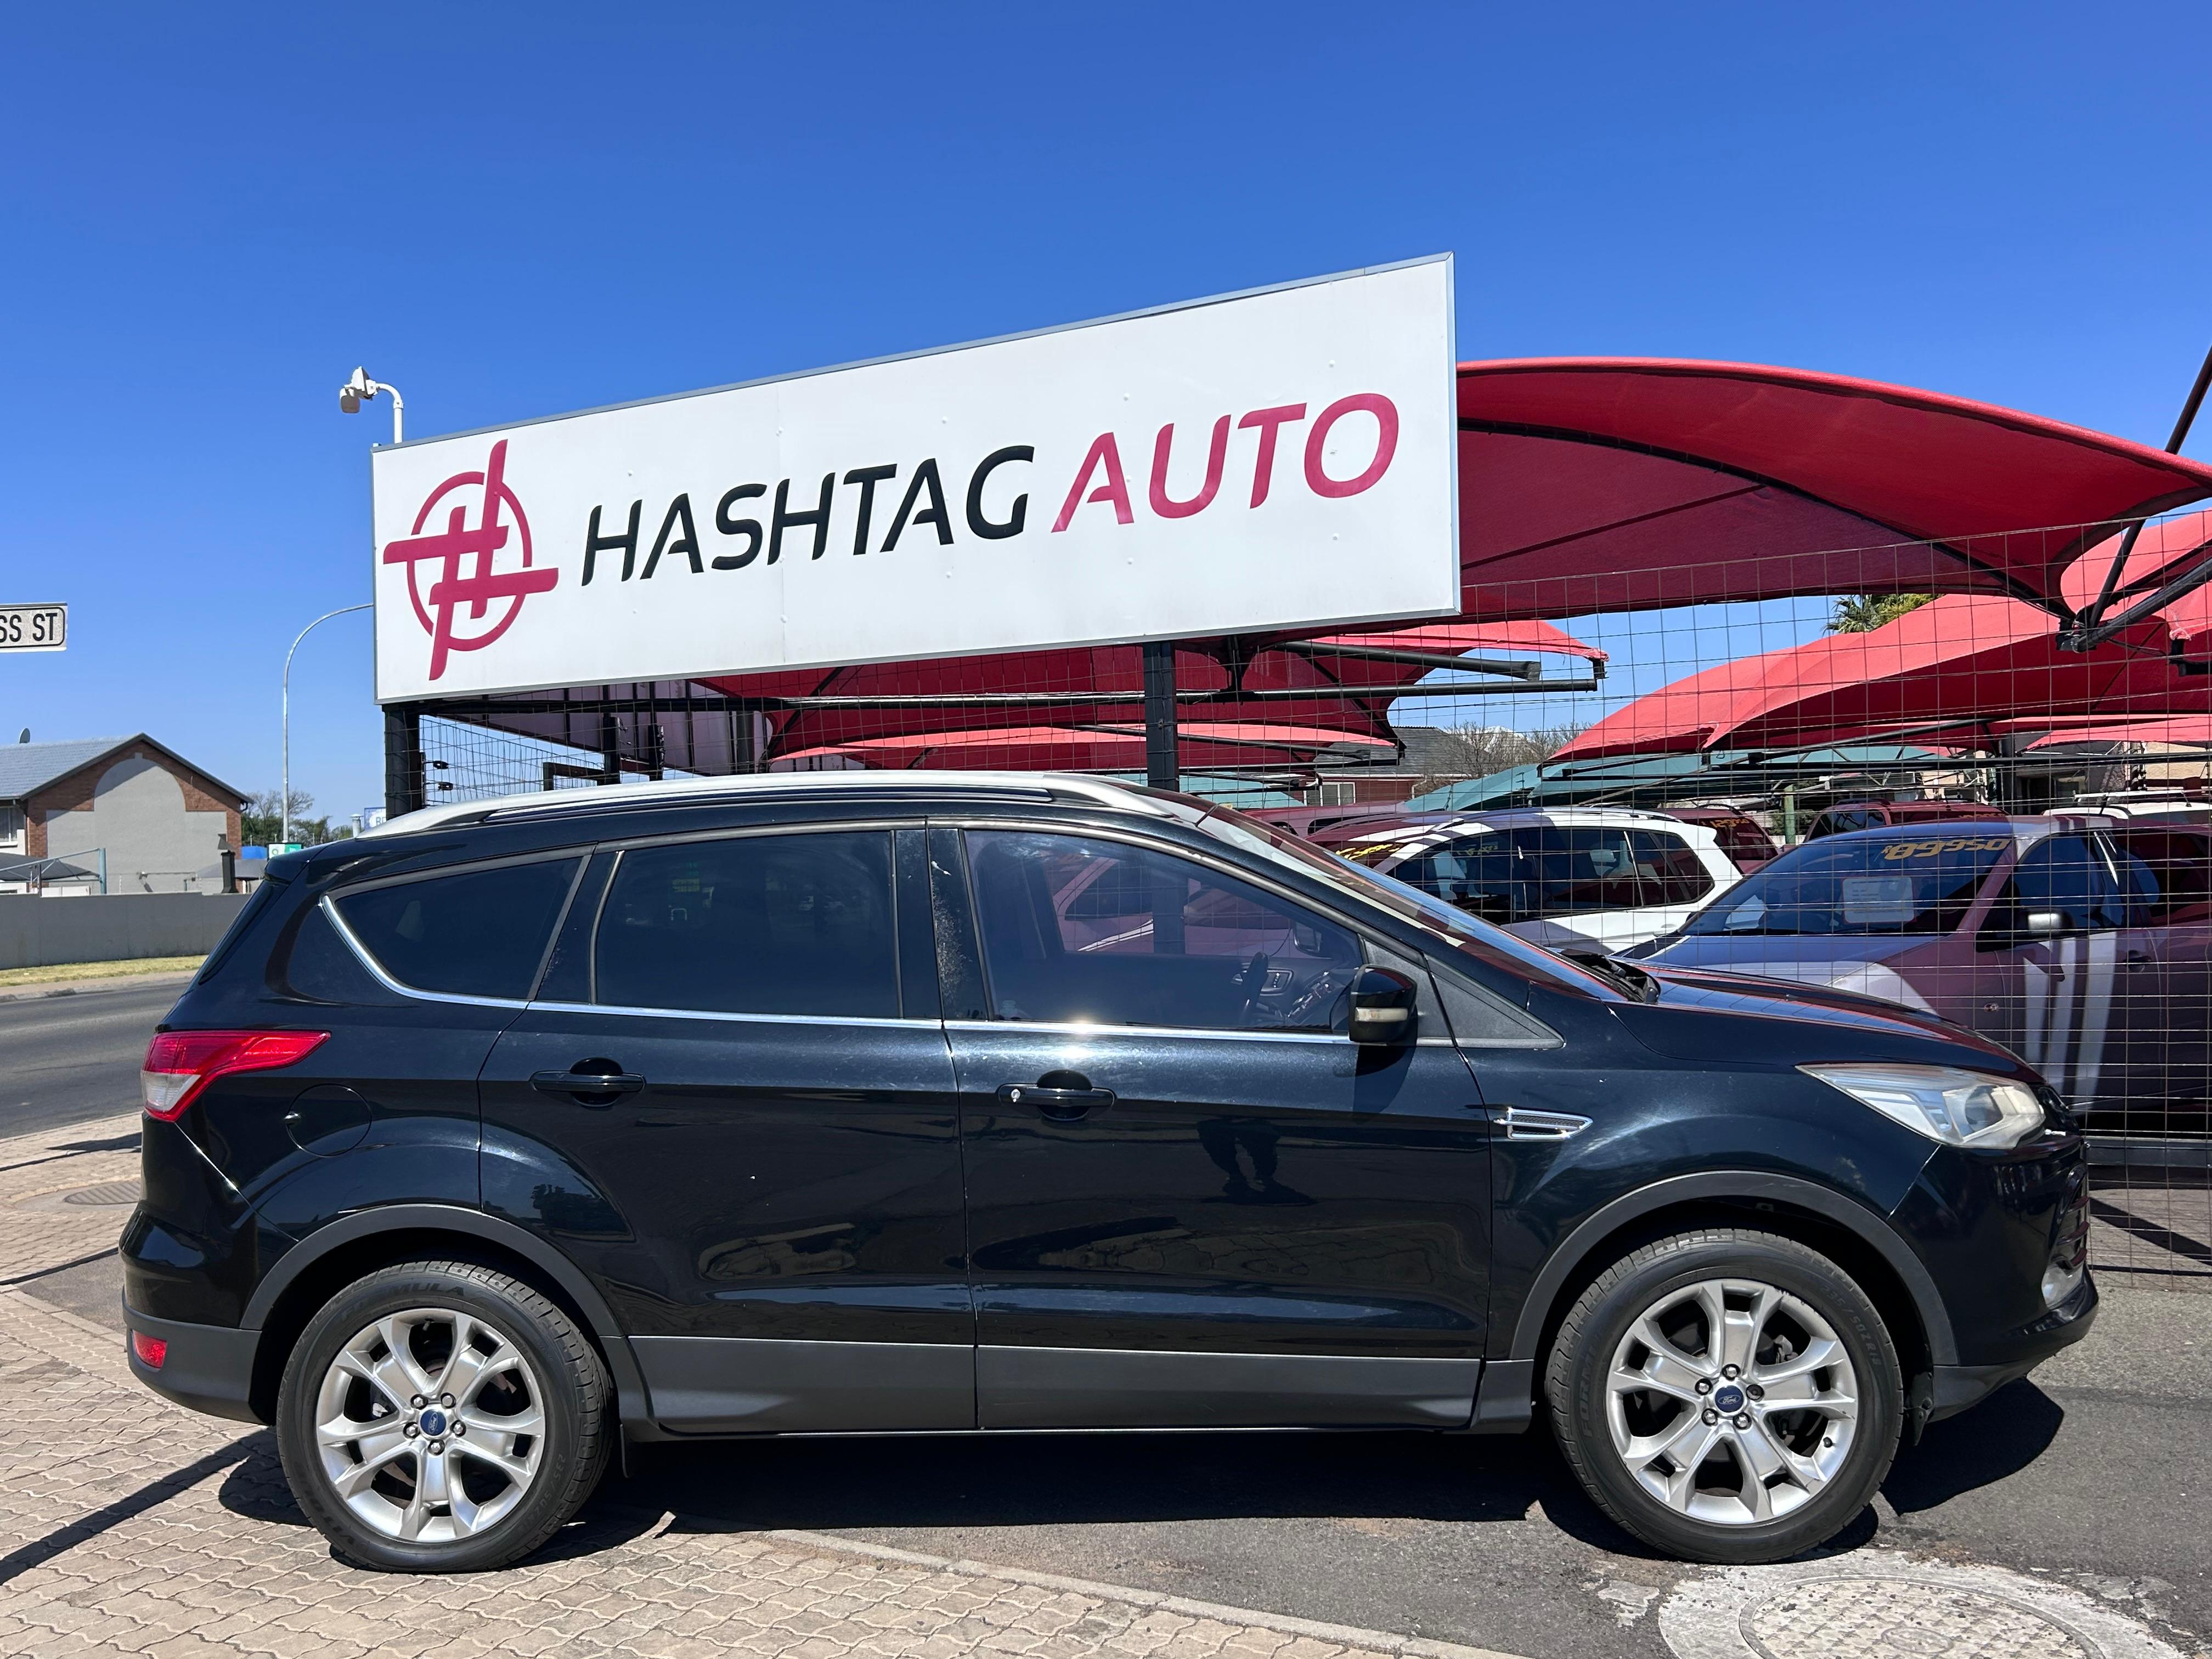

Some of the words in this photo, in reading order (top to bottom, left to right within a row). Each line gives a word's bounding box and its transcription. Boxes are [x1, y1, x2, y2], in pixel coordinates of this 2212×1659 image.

[582, 445, 1034, 586] HASHTAG
[1052, 393, 1398, 532] AUTO
[33, 613, 58, 641] ST
